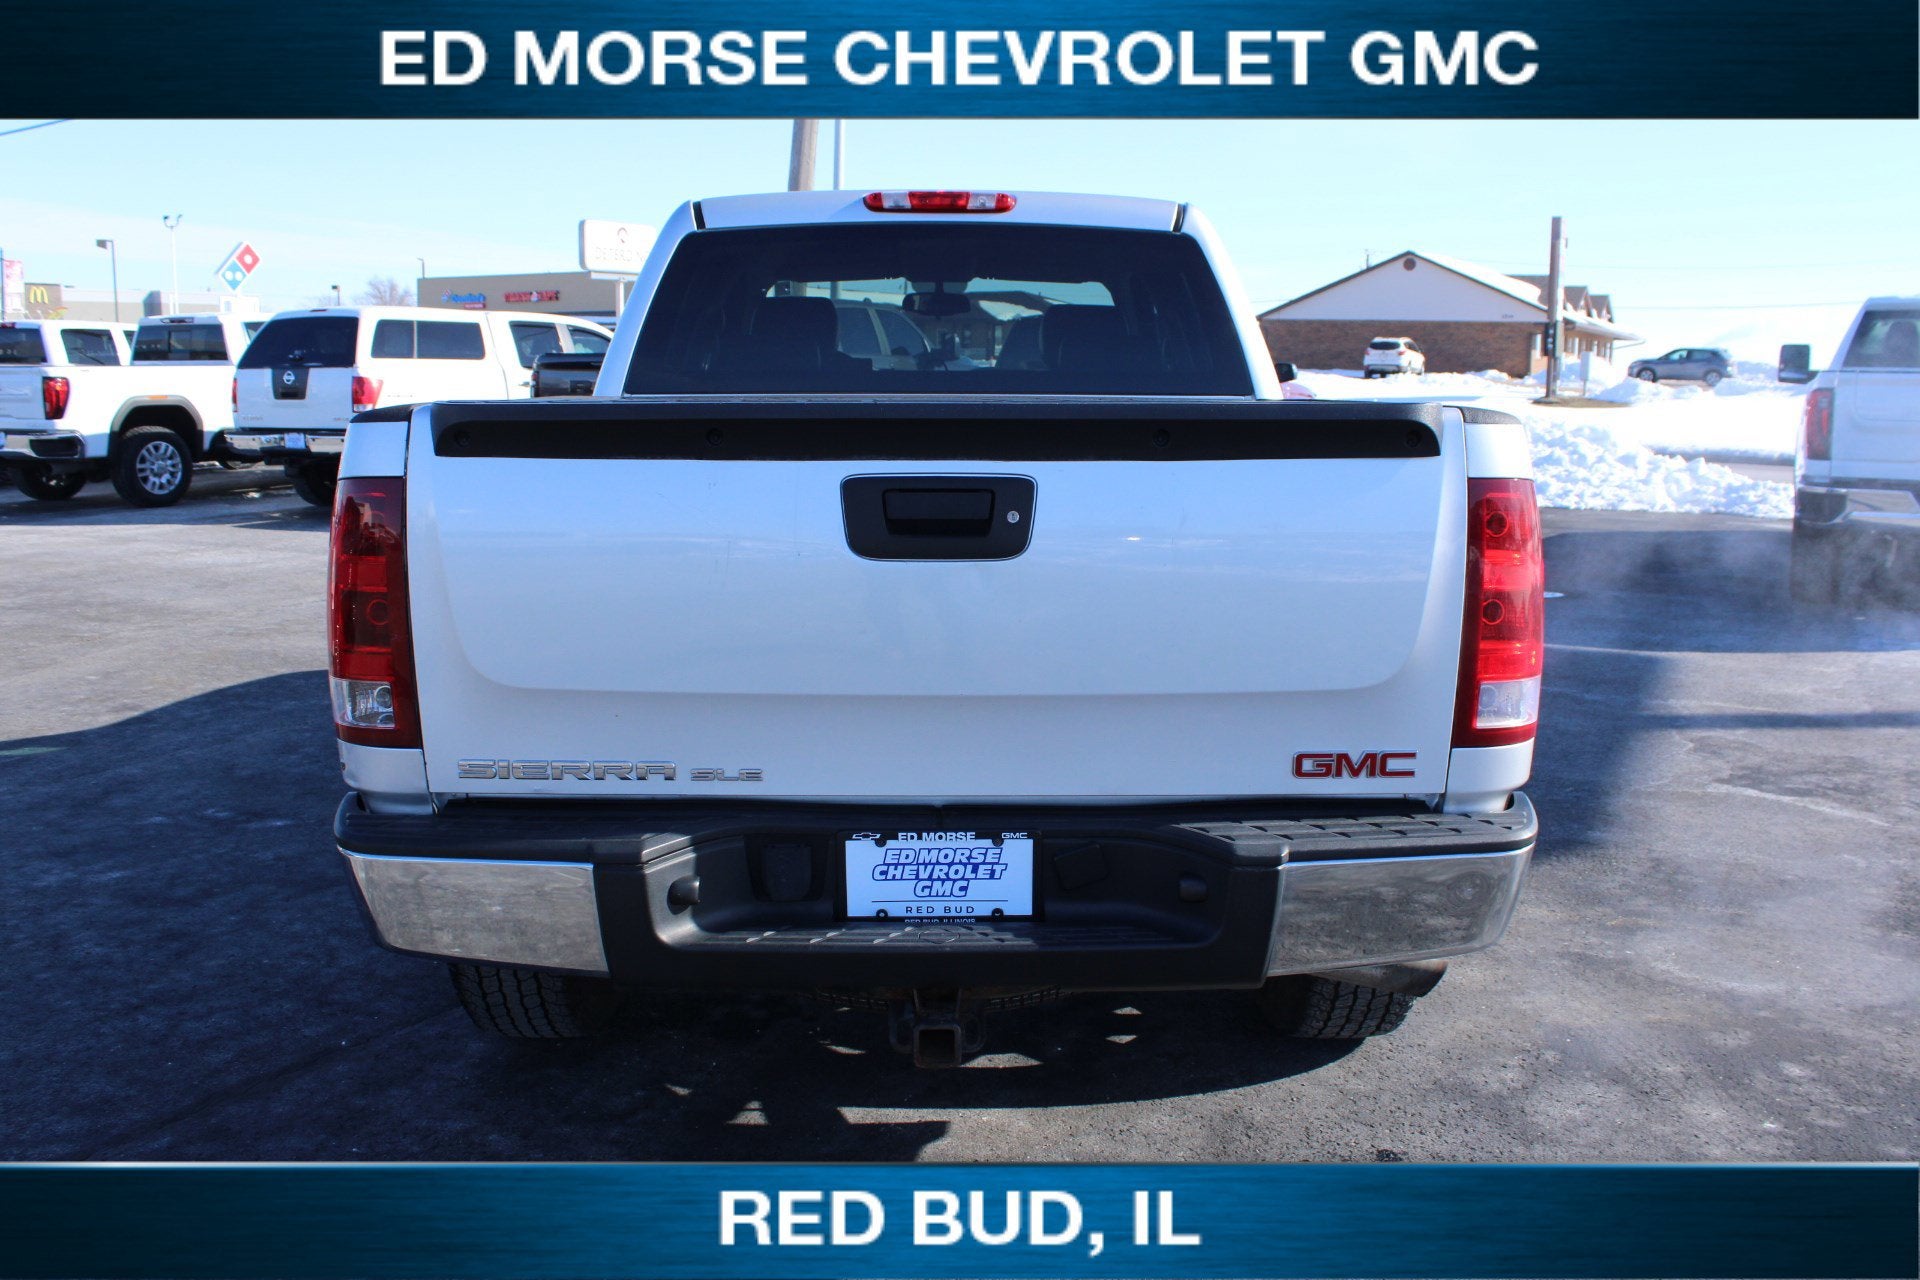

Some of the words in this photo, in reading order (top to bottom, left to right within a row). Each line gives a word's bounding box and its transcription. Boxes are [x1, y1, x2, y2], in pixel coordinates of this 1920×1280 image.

[457, 759, 676, 781] SIERRA
[690, 768, 763, 781] SLE
[1292, 750, 1418, 779] GMC
[898, 832, 917, 842] ED
[922, 832, 976, 842] MORSE
[883, 848, 916, 864] ED
[915, 847, 1003, 863] MORSE
[872, 863, 1008, 881] CHEVROLET
[914, 880, 969, 897] GMC
[905, 906, 935, 914] RED
[944, 906, 975, 914] BUD
